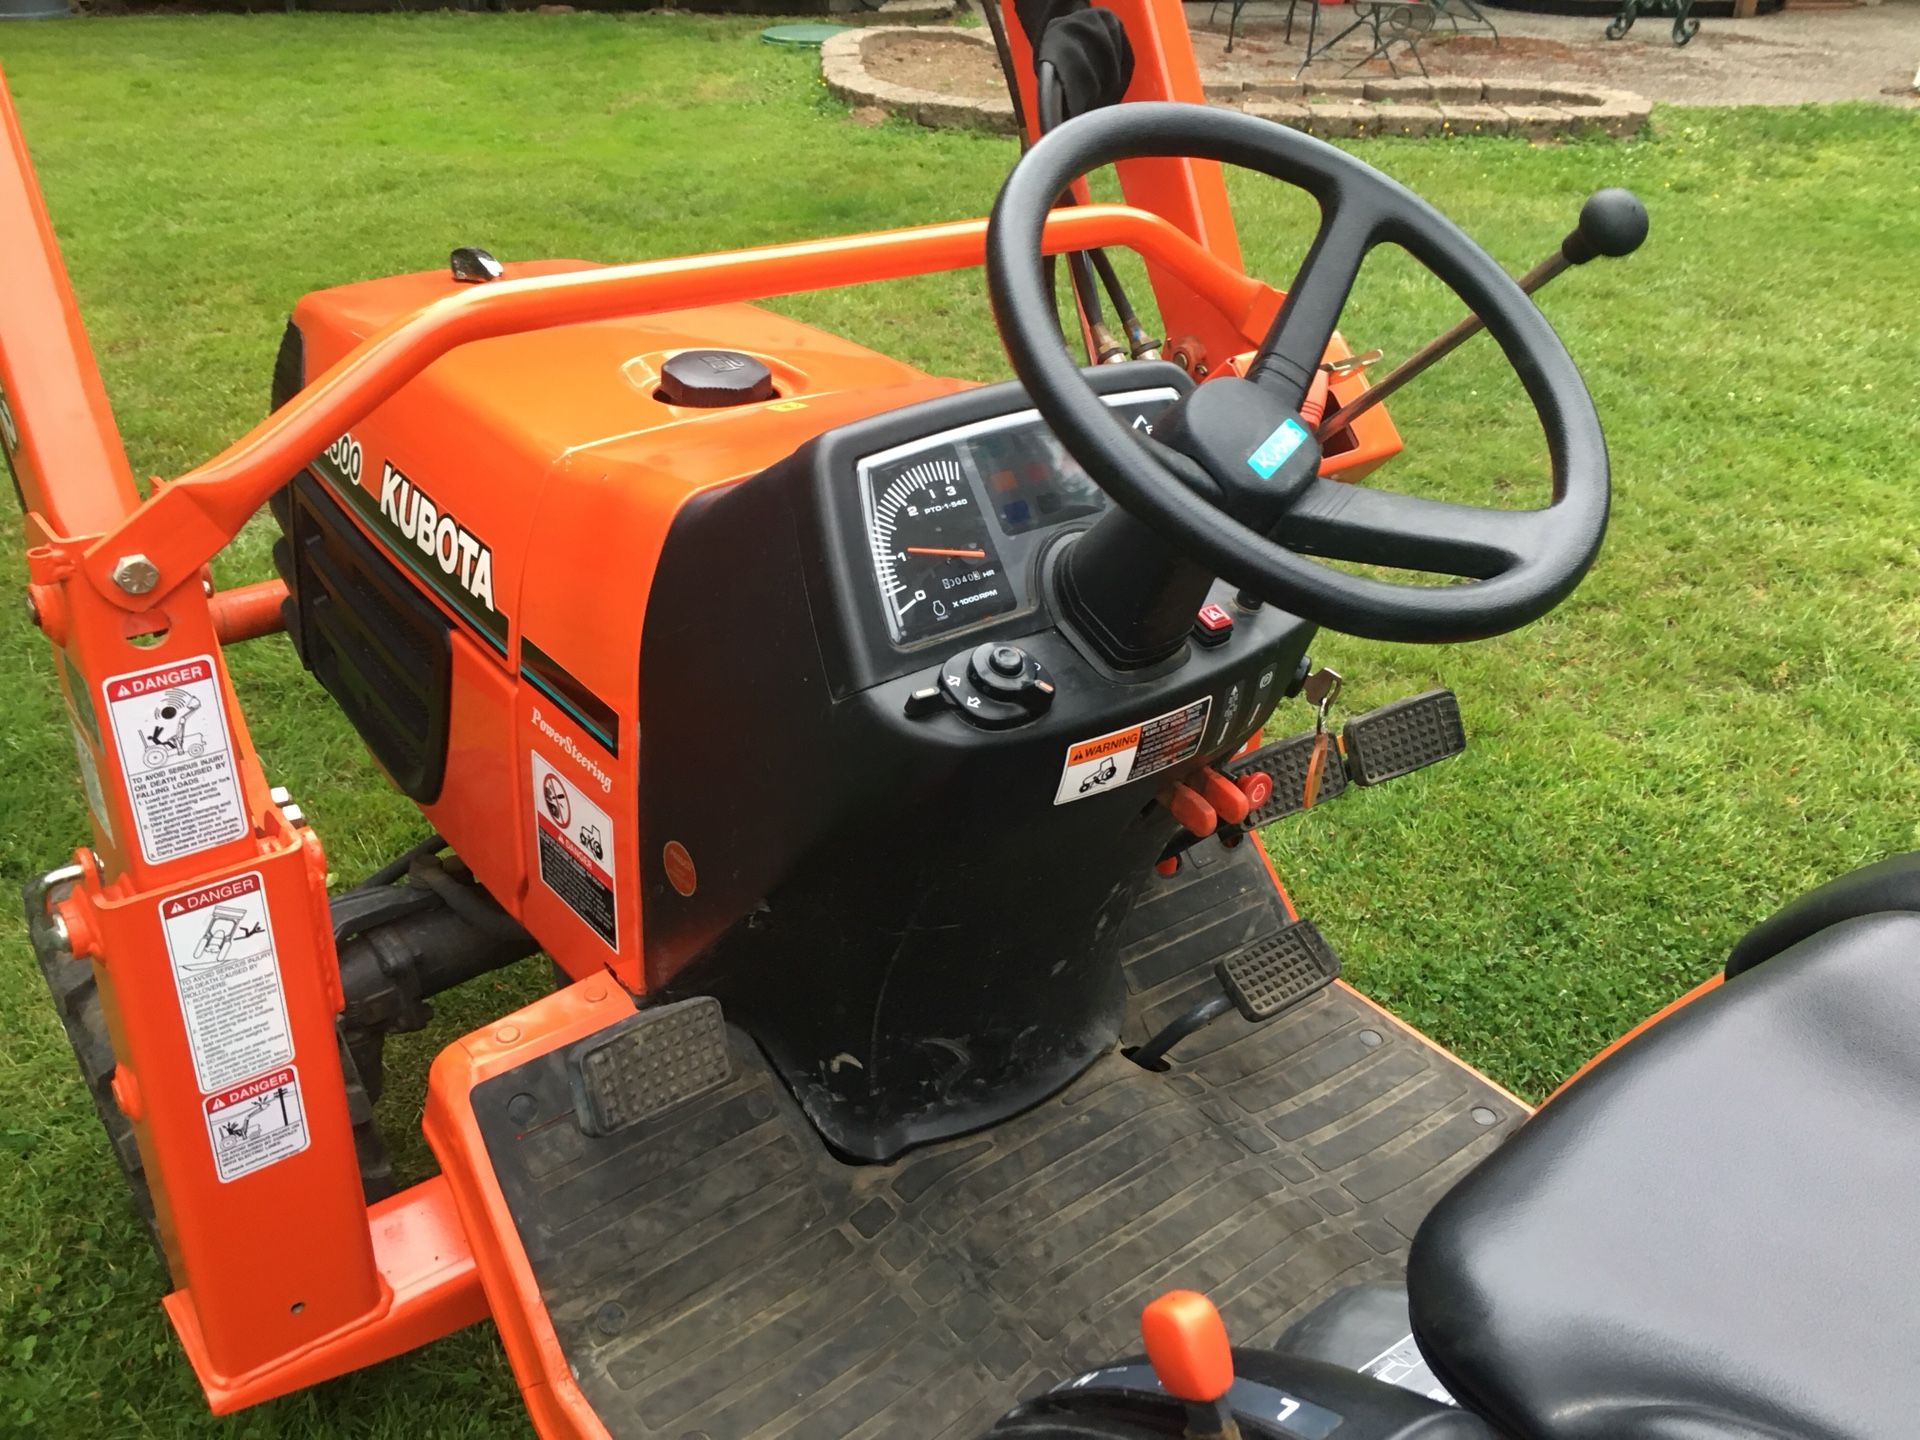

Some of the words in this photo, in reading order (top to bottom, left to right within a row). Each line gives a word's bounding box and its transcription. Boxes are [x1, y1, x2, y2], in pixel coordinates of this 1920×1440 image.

[945, 485, 957, 496] 3
[906, 505, 919, 517] 2
[380, 463, 494, 612] KUBOTA
[897, 551, 907, 562] 1
[914, 589, 927, 601] 0
[132, 665, 203, 693] DANGER
[1084, 732, 1138, 757] WARNING
[187, 878, 255, 910] DANGER
[228, 1072, 290, 1104] DANGER
